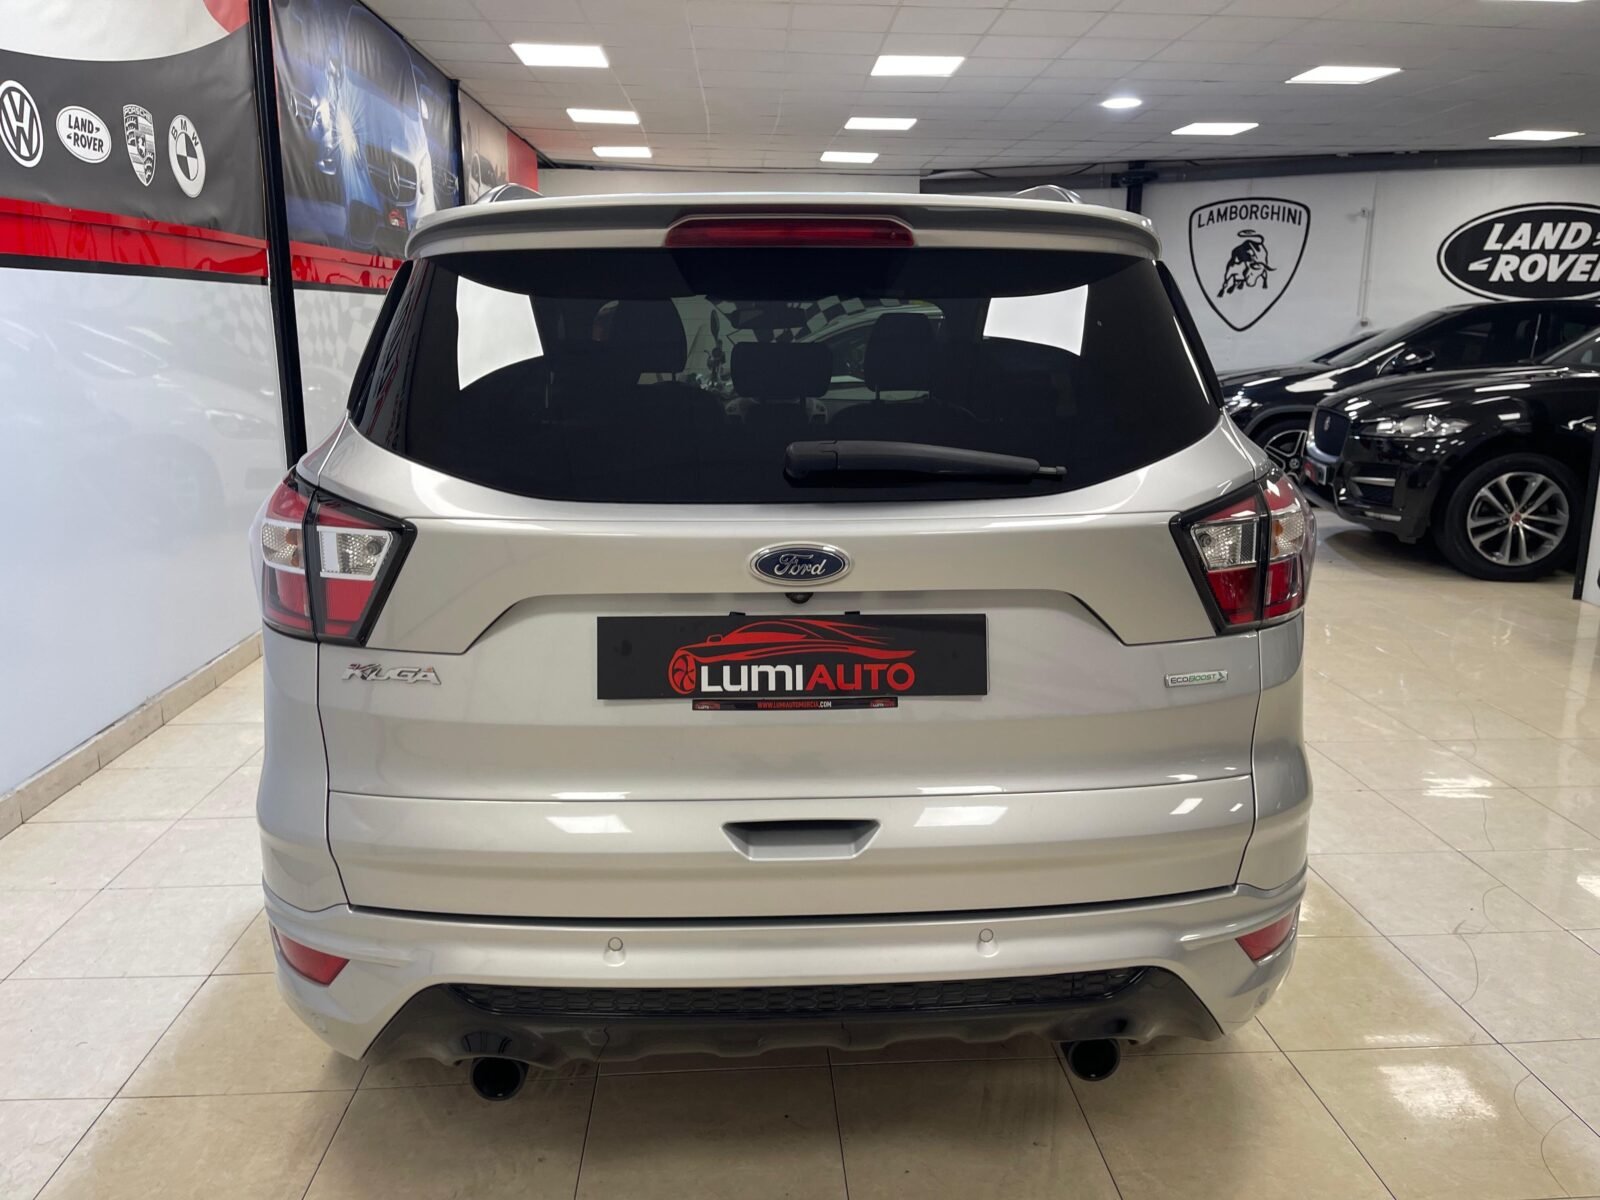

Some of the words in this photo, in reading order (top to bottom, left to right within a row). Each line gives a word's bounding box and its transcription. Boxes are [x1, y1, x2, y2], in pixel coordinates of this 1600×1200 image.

[68, 114, 93, 134] LAND
[171, 118, 199, 147] BMW
[73, 134, 104, 153] ROVER
[1197, 204, 1302, 228] LAMBORGHINI
[1483, 222, 1592, 250] LAND
[774, 554, 827, 575] Ford
[342, 664, 442, 685] KUGA
[701, 662, 916, 692] LUMIAUTO
[1170, 673, 1217, 684] ECOBOOST
